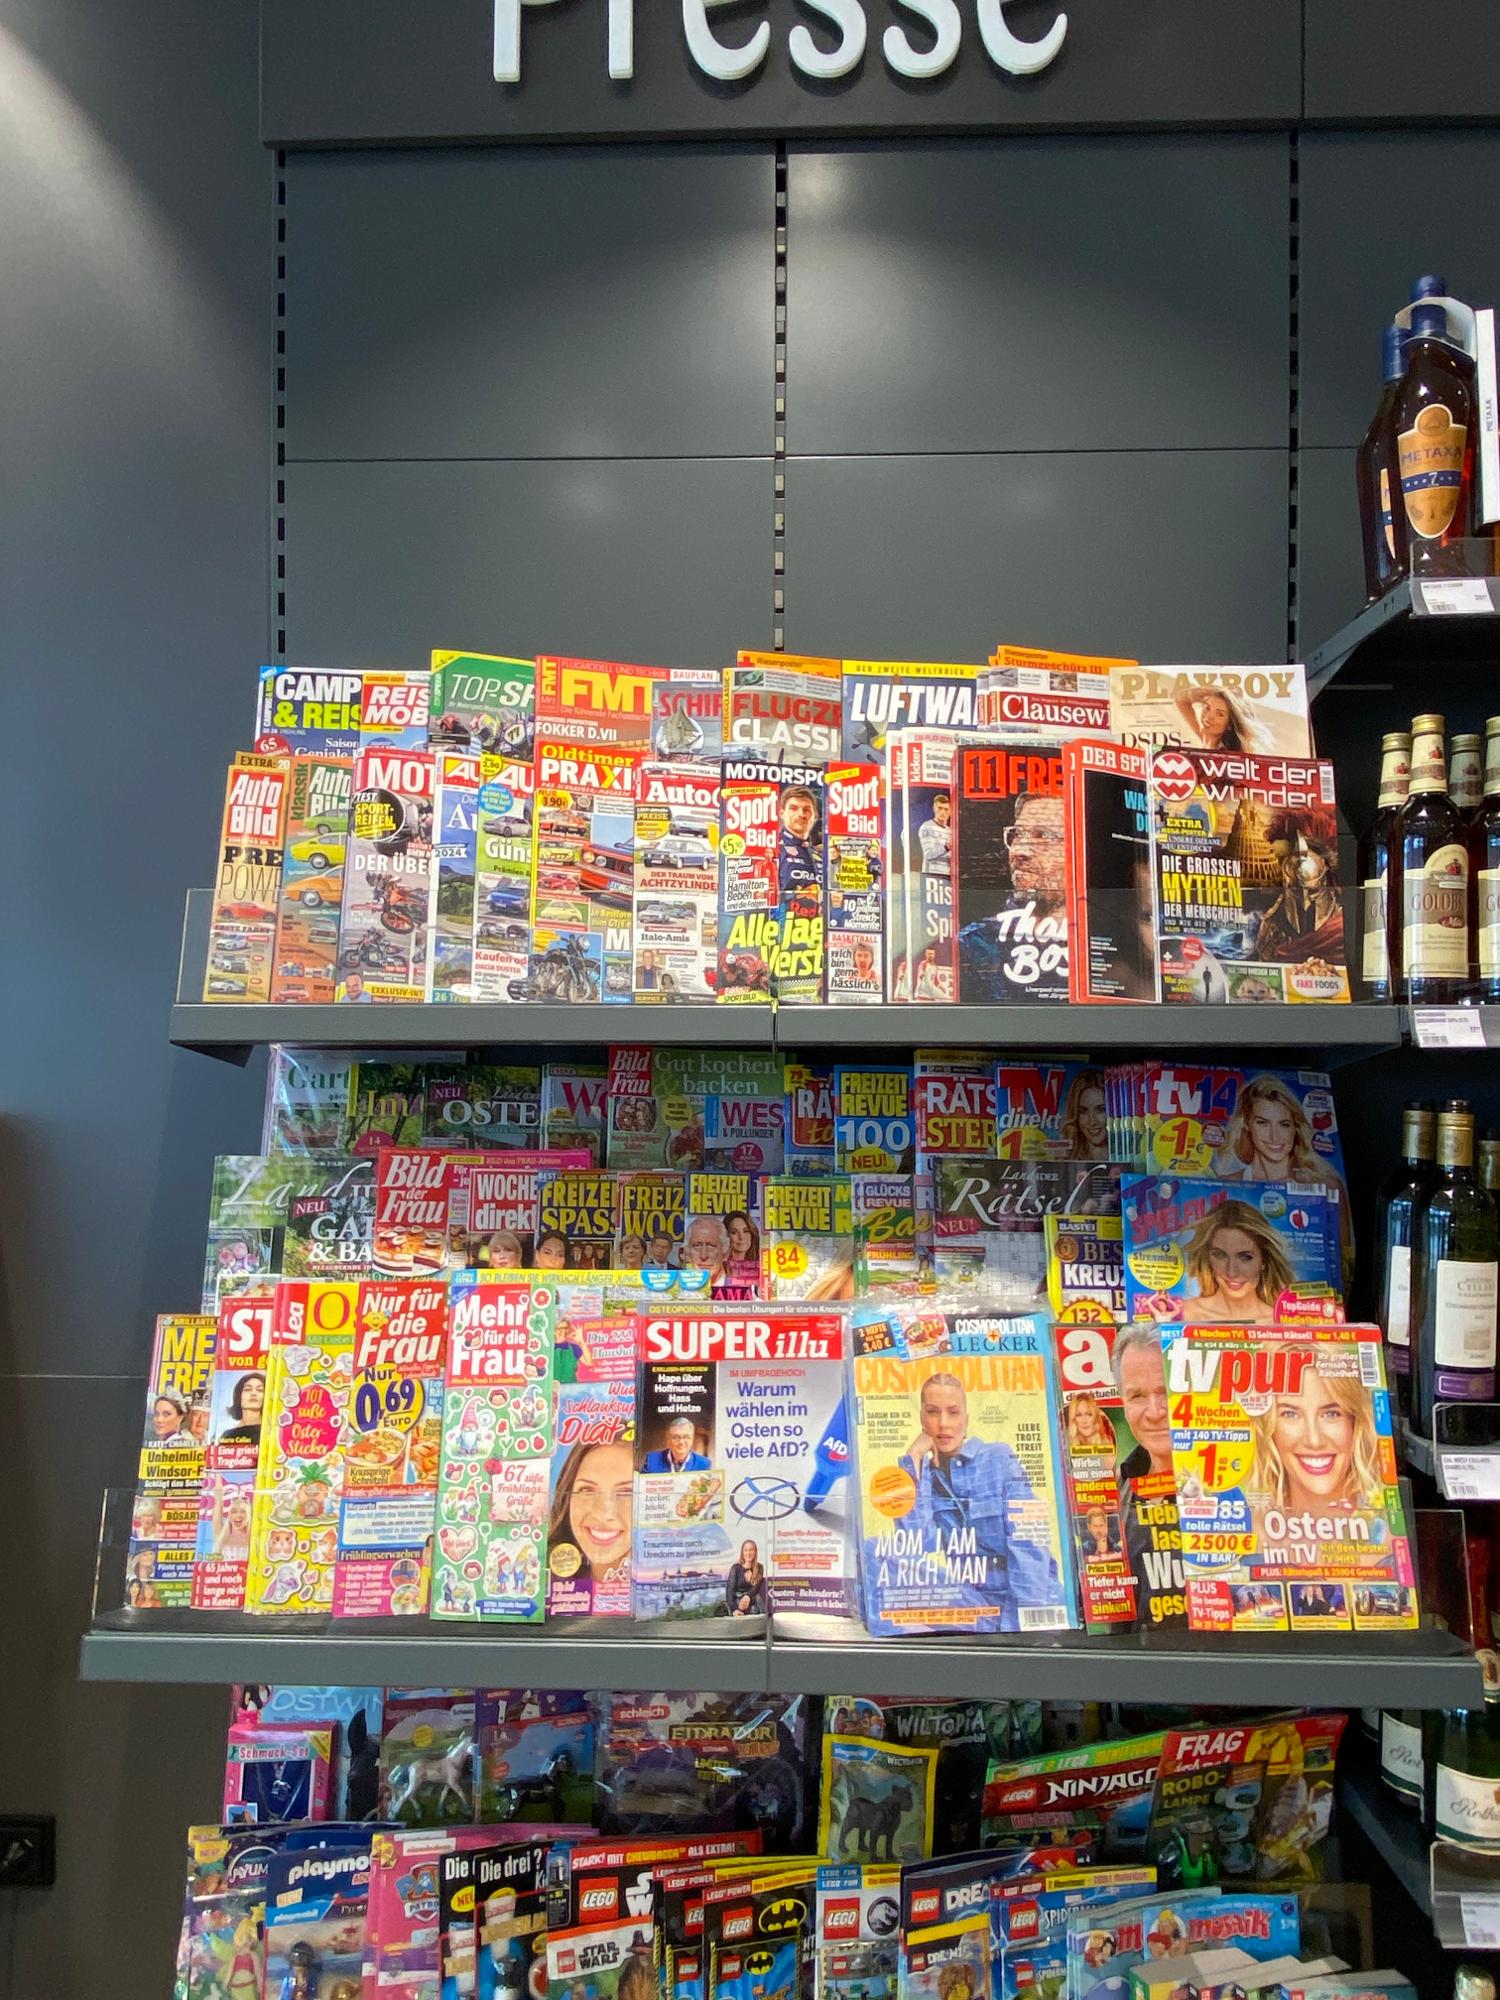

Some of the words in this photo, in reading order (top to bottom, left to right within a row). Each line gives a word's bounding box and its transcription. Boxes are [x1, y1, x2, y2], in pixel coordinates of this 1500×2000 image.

[1485, 398, 1494, 433] METAXA
[1401, 446, 1462, 464] METAXA
[541, 657, 557, 696] FMT
[673, 670, 714, 681] BAUPLAN
[856, 664, 873, 673] DER
[878, 665, 911, 675] ZWEITE
[915, 667, 965, 676] WELTKRIEG
[561, 669, 651, 714] FMT
[1120, 672, 1295, 701] PLAYBOY
[850, 682, 977, 726] LUFTWA
[536, 721, 584, 739] FOKKER
[587, 726, 617, 741] D.VII
[259, 737, 277, 753] 65
[542, 744, 634, 768] Oldtimer
[1082, 746, 1117, 768] DER
[1199, 757, 1261, 782] welt
[1268, 761, 1317, 786] der
[229, 773, 283, 808] Auto
[829, 775, 880, 817] Sport
[1200, 782, 1318, 809] wunder
[727, 790, 779, 830] Sport
[229, 805, 279, 837] Bild
[848, 813, 879, 835] Bild
[1166, 818, 1203, 829] EXTRA
[745, 828, 778, 848] Bild
[223, 845, 283, 868] PRE
[355, 854, 388, 871] DER
[391, 852, 432, 876] ÜBE
[434, 849, 462, 858] 2024
[1162, 855, 1182, 873] DIE
[1186, 858, 1241, 878] GROSSEN
[727, 878, 769, 892] Hamilton-
[1162, 873, 1243, 908] MYTHEN
[1164, 902, 1182, 918] DER
[1185, 905, 1244, 922] MENSCHHEIT
[640, 933, 691, 943] Italo-Amis
[831, 933, 879, 944] BASKETBALL
[1296, 979, 1314, 989] FAKE
[1315, 979, 1339, 990] FOODS
[612, 1050, 650, 1072] Bild
[654, 1051, 694, 1074] Gut
[701, 1054, 778, 1075] kochen
[610, 1073, 650, 1094] Frau
[682, 1073, 760, 1095] backen
[840, 1072, 908, 1094] FREIZEIT
[442, 1100, 540, 1127] OSTE
[721, 1101, 785, 1128] WES
[999, 1107, 1062, 1130] direkt
[838, 1120, 911, 1151] 100
[381, 1153, 449, 1189] Bild
[851, 1153, 888, 1170] NEU!
[221, 1161, 373, 1207] Land
[405, 1187, 428, 1199] der
[688, 1173, 749, 1194] FREIZEIT
[865, 1182, 912, 1198] GLÜCKS
[688, 1192, 749, 1214] REVUE
[764, 1185, 832, 1207] FREIZEIT
[865, 1197, 912, 1209] REVUE
[949, 1164, 1108, 1227] Rätsel
[378, 1189, 446, 1224] Frau
[764, 1207, 832, 1230] REVUE
[935, 1217, 976, 1233] NEU!
[1058, 1221, 1097, 1232] BASTEI
[775, 1246, 800, 1265] 84
[361, 1292, 406, 1315] Nur
[409, 1287, 444, 1312] für
[453, 1294, 530, 1329] Mehr
[281, 1301, 305, 1342] Lea
[387, 1312, 428, 1336] die
[1070, 1308, 1101, 1323] 132
[484, 1328, 503, 1345] für
[505, 1328, 526, 1345] die
[954, 1318, 1036, 1336] COSMOPOLITAN
[1161, 1330, 1181, 1338] BEST
[357, 1331, 441, 1368] Frau
[957, 1336, 1039, 1352] LECKER
[451, 1334, 525, 1377] Frau
[1062, 1329, 1117, 1387] a
[363, 1368, 395, 1382] Nur
[736, 1382, 796, 1398] Warum
[355, 1378, 416, 1432] 0,69
[725, 1402, 785, 1419] wählen
[787, 1403, 808, 1417] im
[1171, 1394, 1194, 1428] 4
[1195, 1405, 1240, 1418] Wochen
[382, 1416, 412, 1428] Euro
[558, 1415, 623, 1446] Diät
[730, 1422, 781, 1438] Osten
[783, 1425, 804, 1437] so
[1017, 1423, 1041, 1432] LIEBE
[1194, 1417, 1251, 1429] TV-Programm
[822, 1436, 849, 1456] AfD
[1015, 1432, 1042, 1442] TROTZ
[1015, 1443, 1043, 1452] STREIT
[725, 1443, 766, 1459] viele
[766, 1441, 809, 1458] AfD?
[349, 1466, 392, 1479] Knusprige
[1074, 1479, 1118, 1492] anderen
[1218, 1500, 1246, 1520] 85
[1263, 1509, 1369, 1541] Ostern
[874, 1529, 929, 1558] MOM,
[935, 1528, 943, 1554] I
[946, 1527, 977, 1555] AM
[1189, 1534, 1239, 1552] 2500
[1241, 1536, 1253, 1550] €
[1263, 1543, 1290, 1564] im
[1291, 1543, 1317, 1564] TV
[876, 1558, 890, 1587] A
[896, 1557, 938, 1587] RICH
[944, 1556, 987, 1585] MAN
[1189, 1581, 1218, 1594] PLUS
[1175, 1730, 1245, 1760] FRAG
[444, 1856, 469, 1881] Die
[480, 1858, 500, 1884] Die
[503, 1851, 531, 1877] drei
[533, 1848, 543, 1870] ?
[580, 1888, 617, 1910] LEGO
[912, 1897, 938, 1911] LEGO
[724, 1917, 752, 1938] LEGO
[826, 1910, 858, 1928] LEGO
[1011, 1911, 1036, 1927] LEGO
[578, 1941, 620, 1959] STAR
[578, 1952, 620, 1970] WARS
